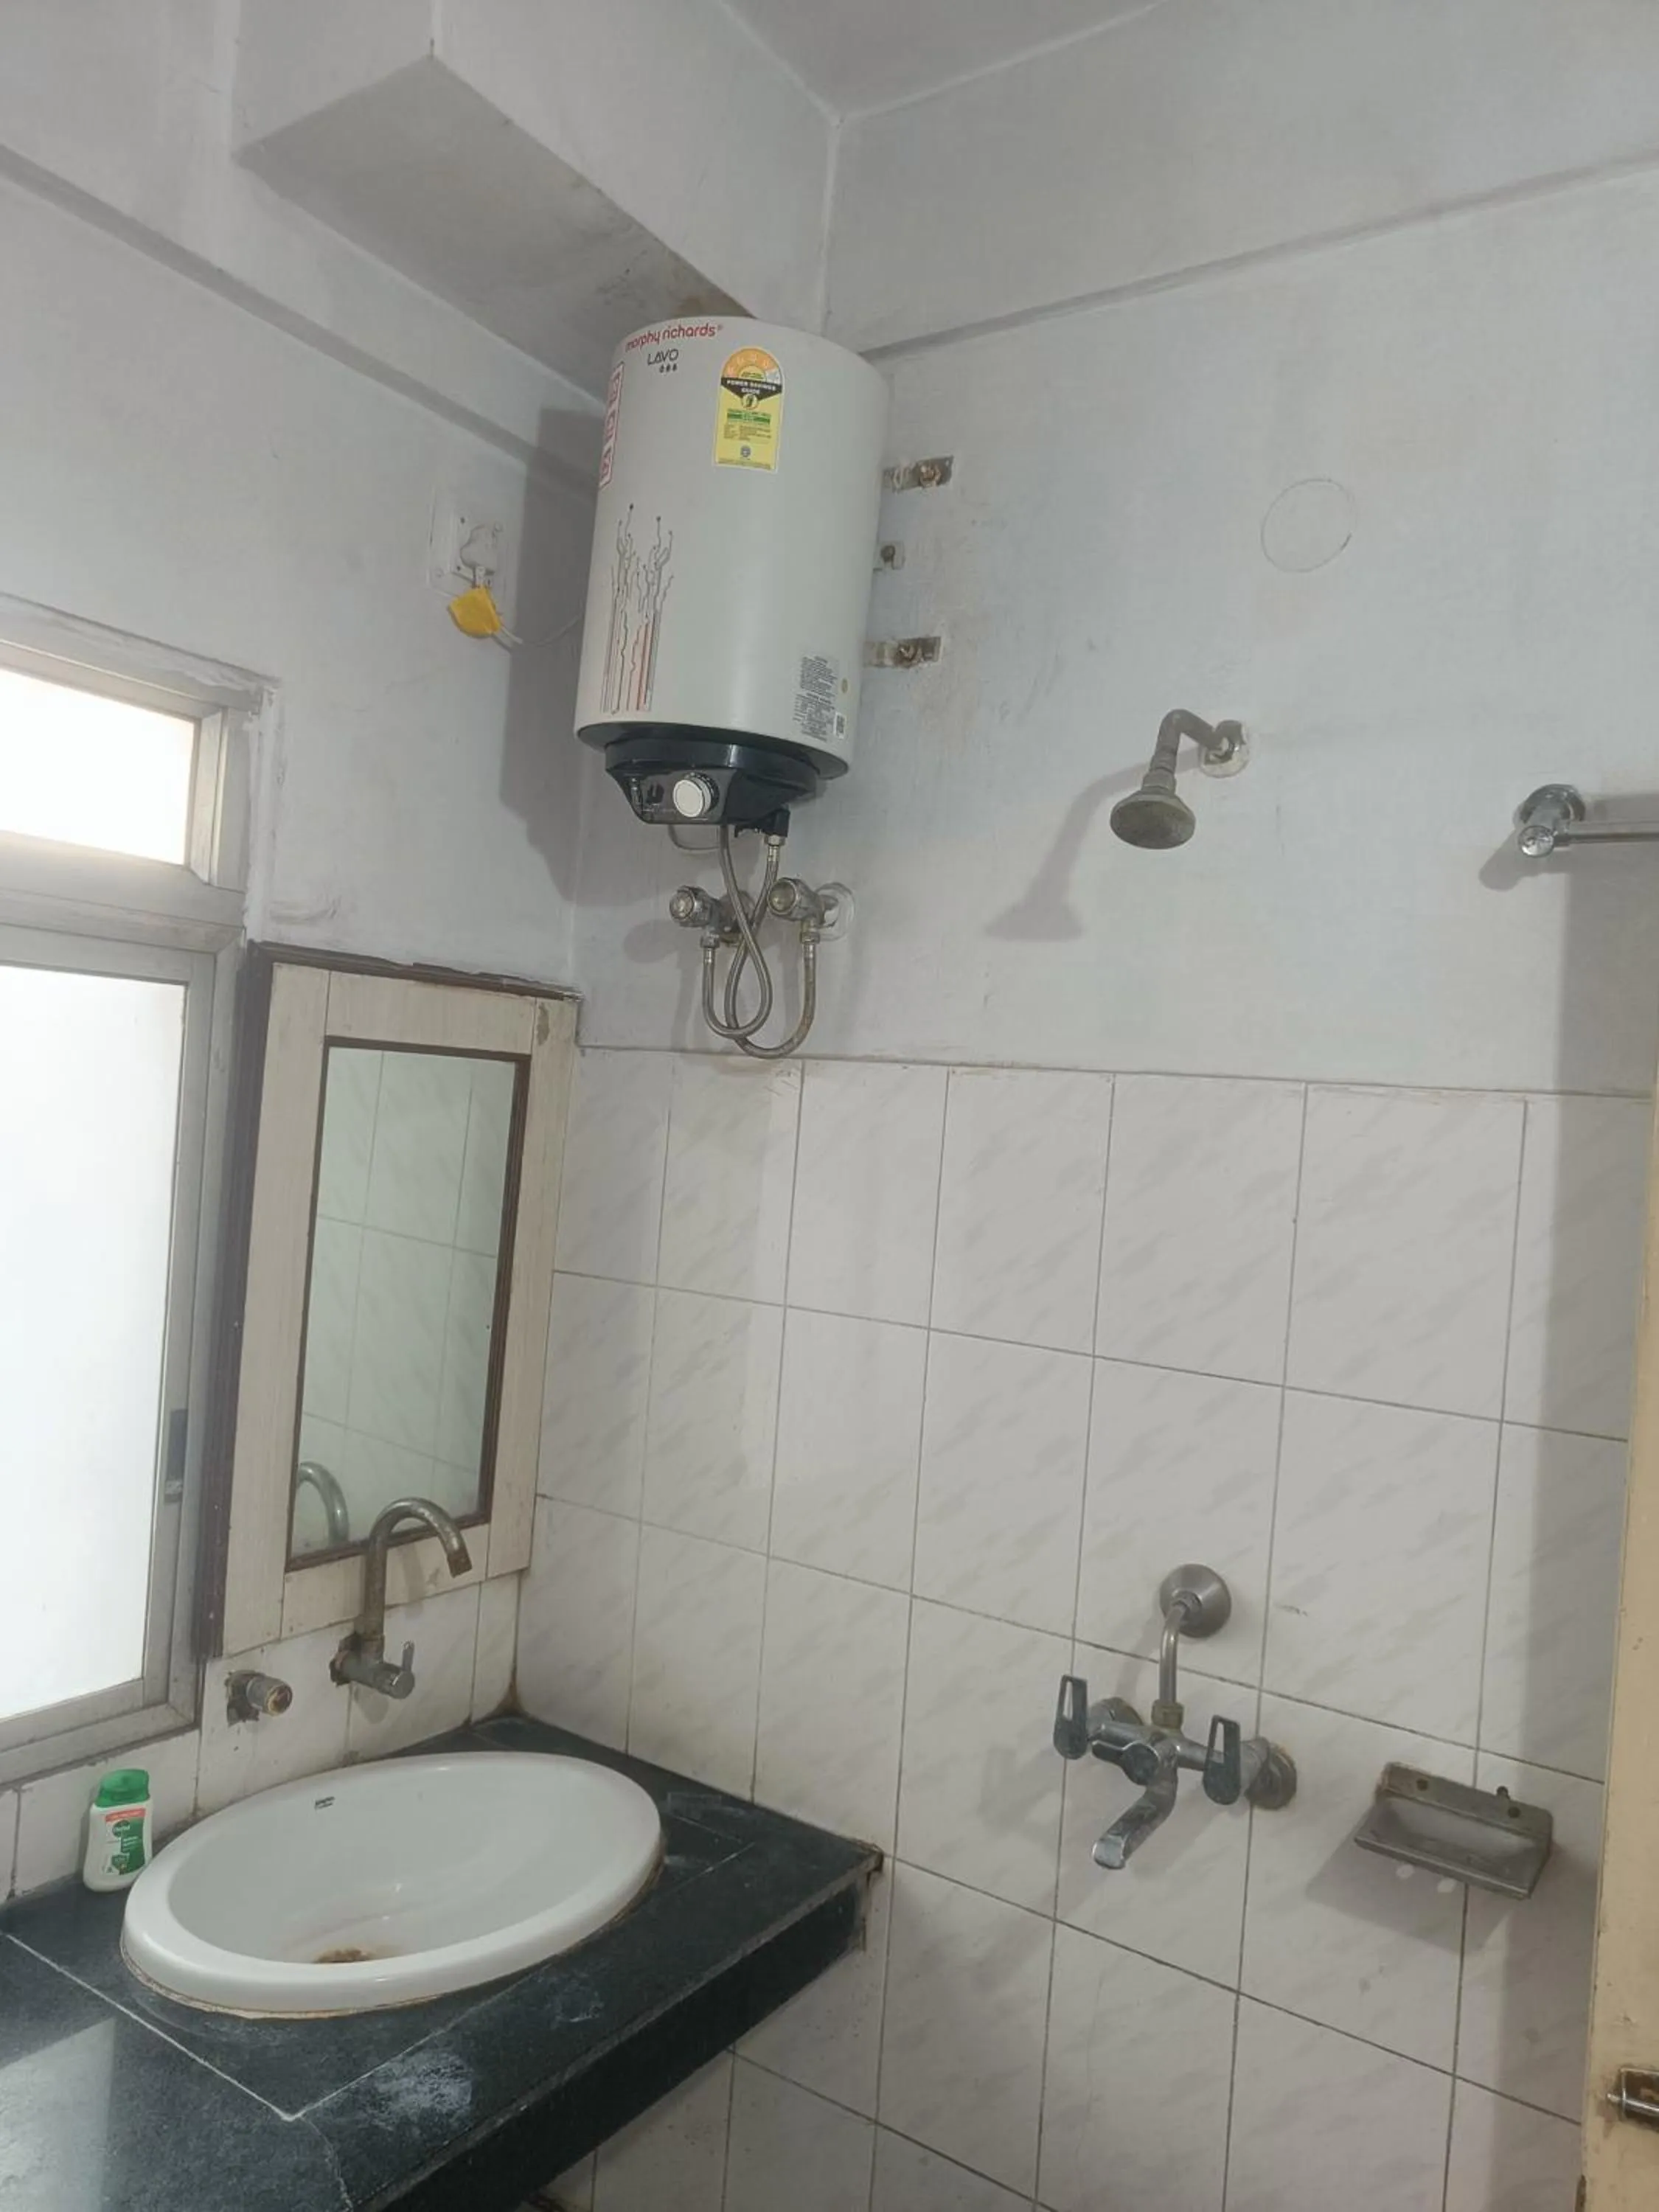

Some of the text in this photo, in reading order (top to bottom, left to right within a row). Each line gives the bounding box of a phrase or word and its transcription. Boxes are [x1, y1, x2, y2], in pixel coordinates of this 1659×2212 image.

[625, 323, 716, 352] morphy richards
[647, 349, 679, 366] LAVO
